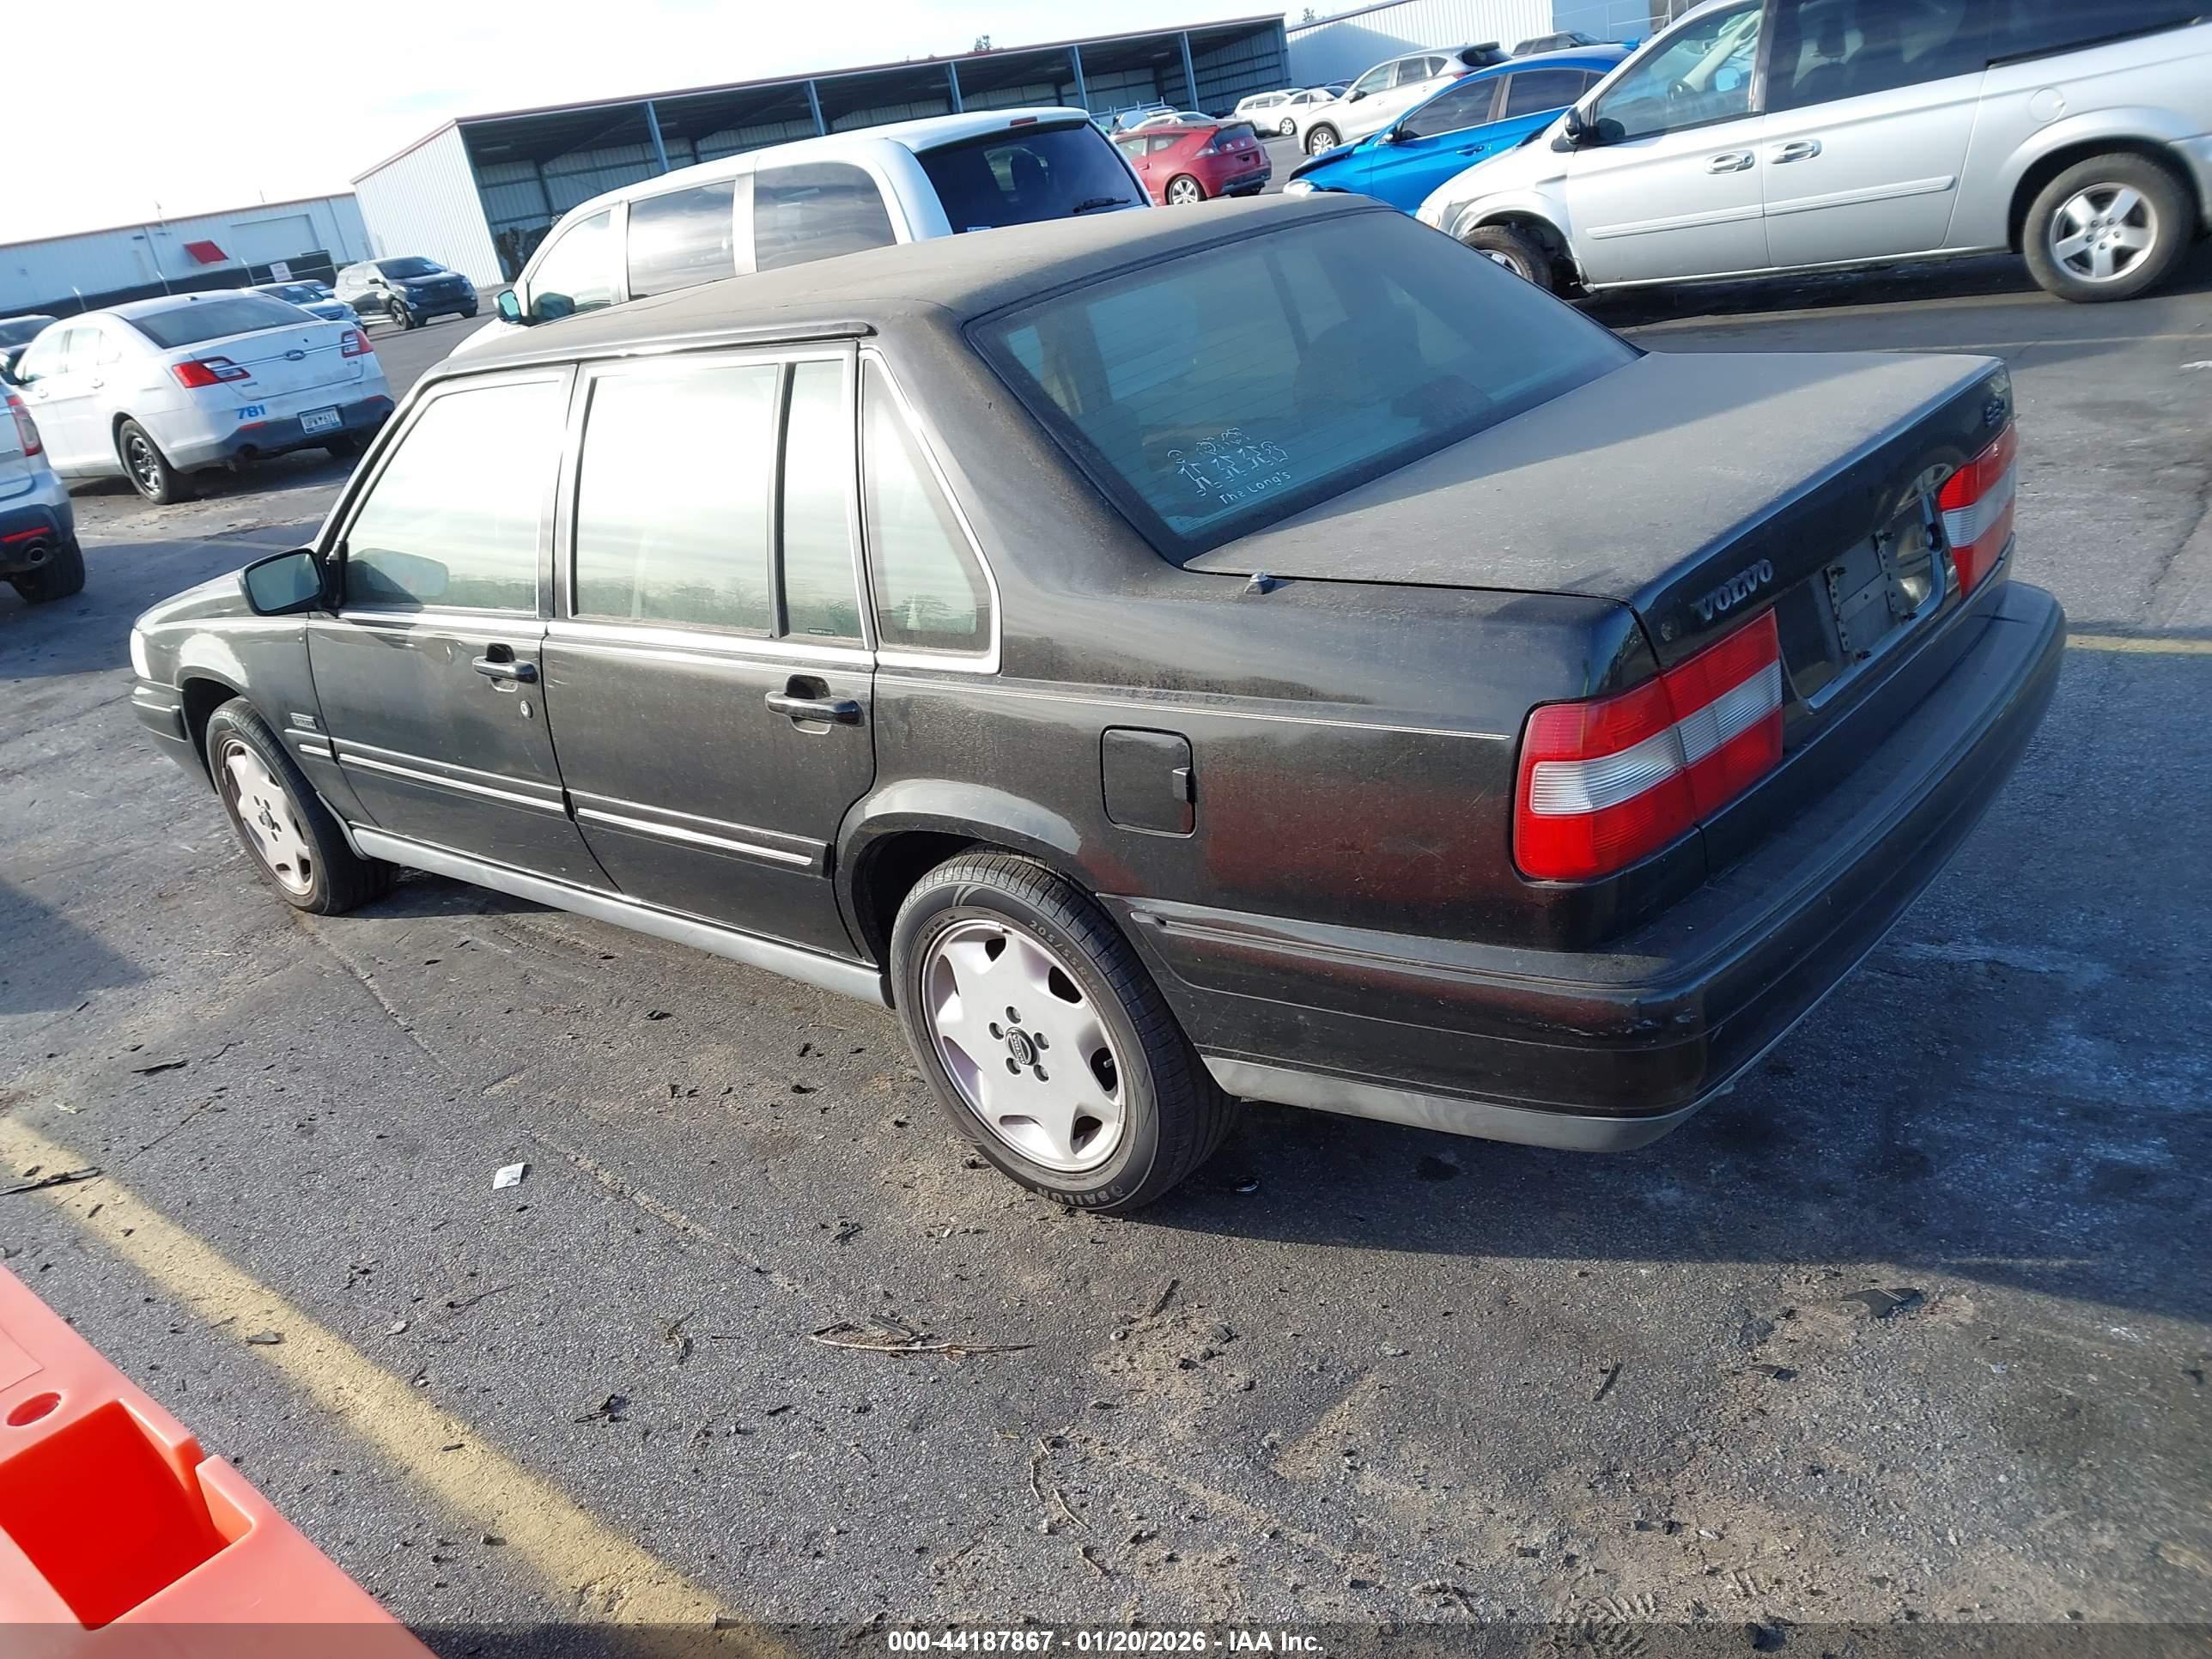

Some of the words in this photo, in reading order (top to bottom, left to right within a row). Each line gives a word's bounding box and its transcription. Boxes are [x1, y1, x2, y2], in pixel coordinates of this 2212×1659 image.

[234, 404, 266, 419] 781
[1218, 489, 1247, 505] The
[1248, 471, 1291, 494] Long's
[1691, 558, 1773, 620] VOLVO
[1036, 1186, 1111, 1206] SAILUN
